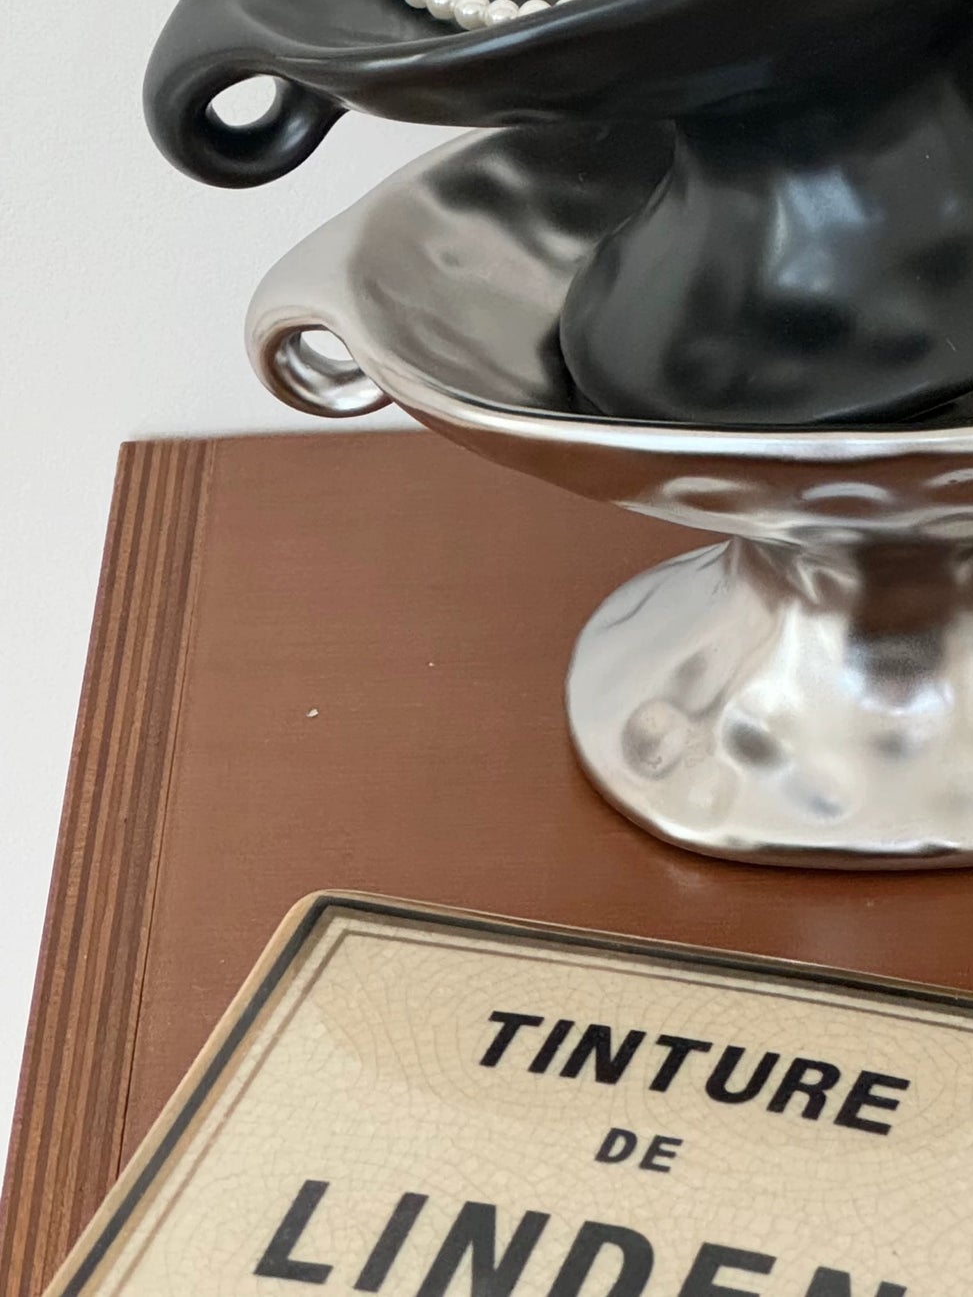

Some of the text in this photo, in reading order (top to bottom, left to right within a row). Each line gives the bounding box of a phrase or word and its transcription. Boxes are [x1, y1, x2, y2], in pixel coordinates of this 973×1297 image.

[479, 1010, 911, 1136] TINTURE
[594, 1127, 684, 1173] DE
[252, 1179, 908, 1297] LINDE
